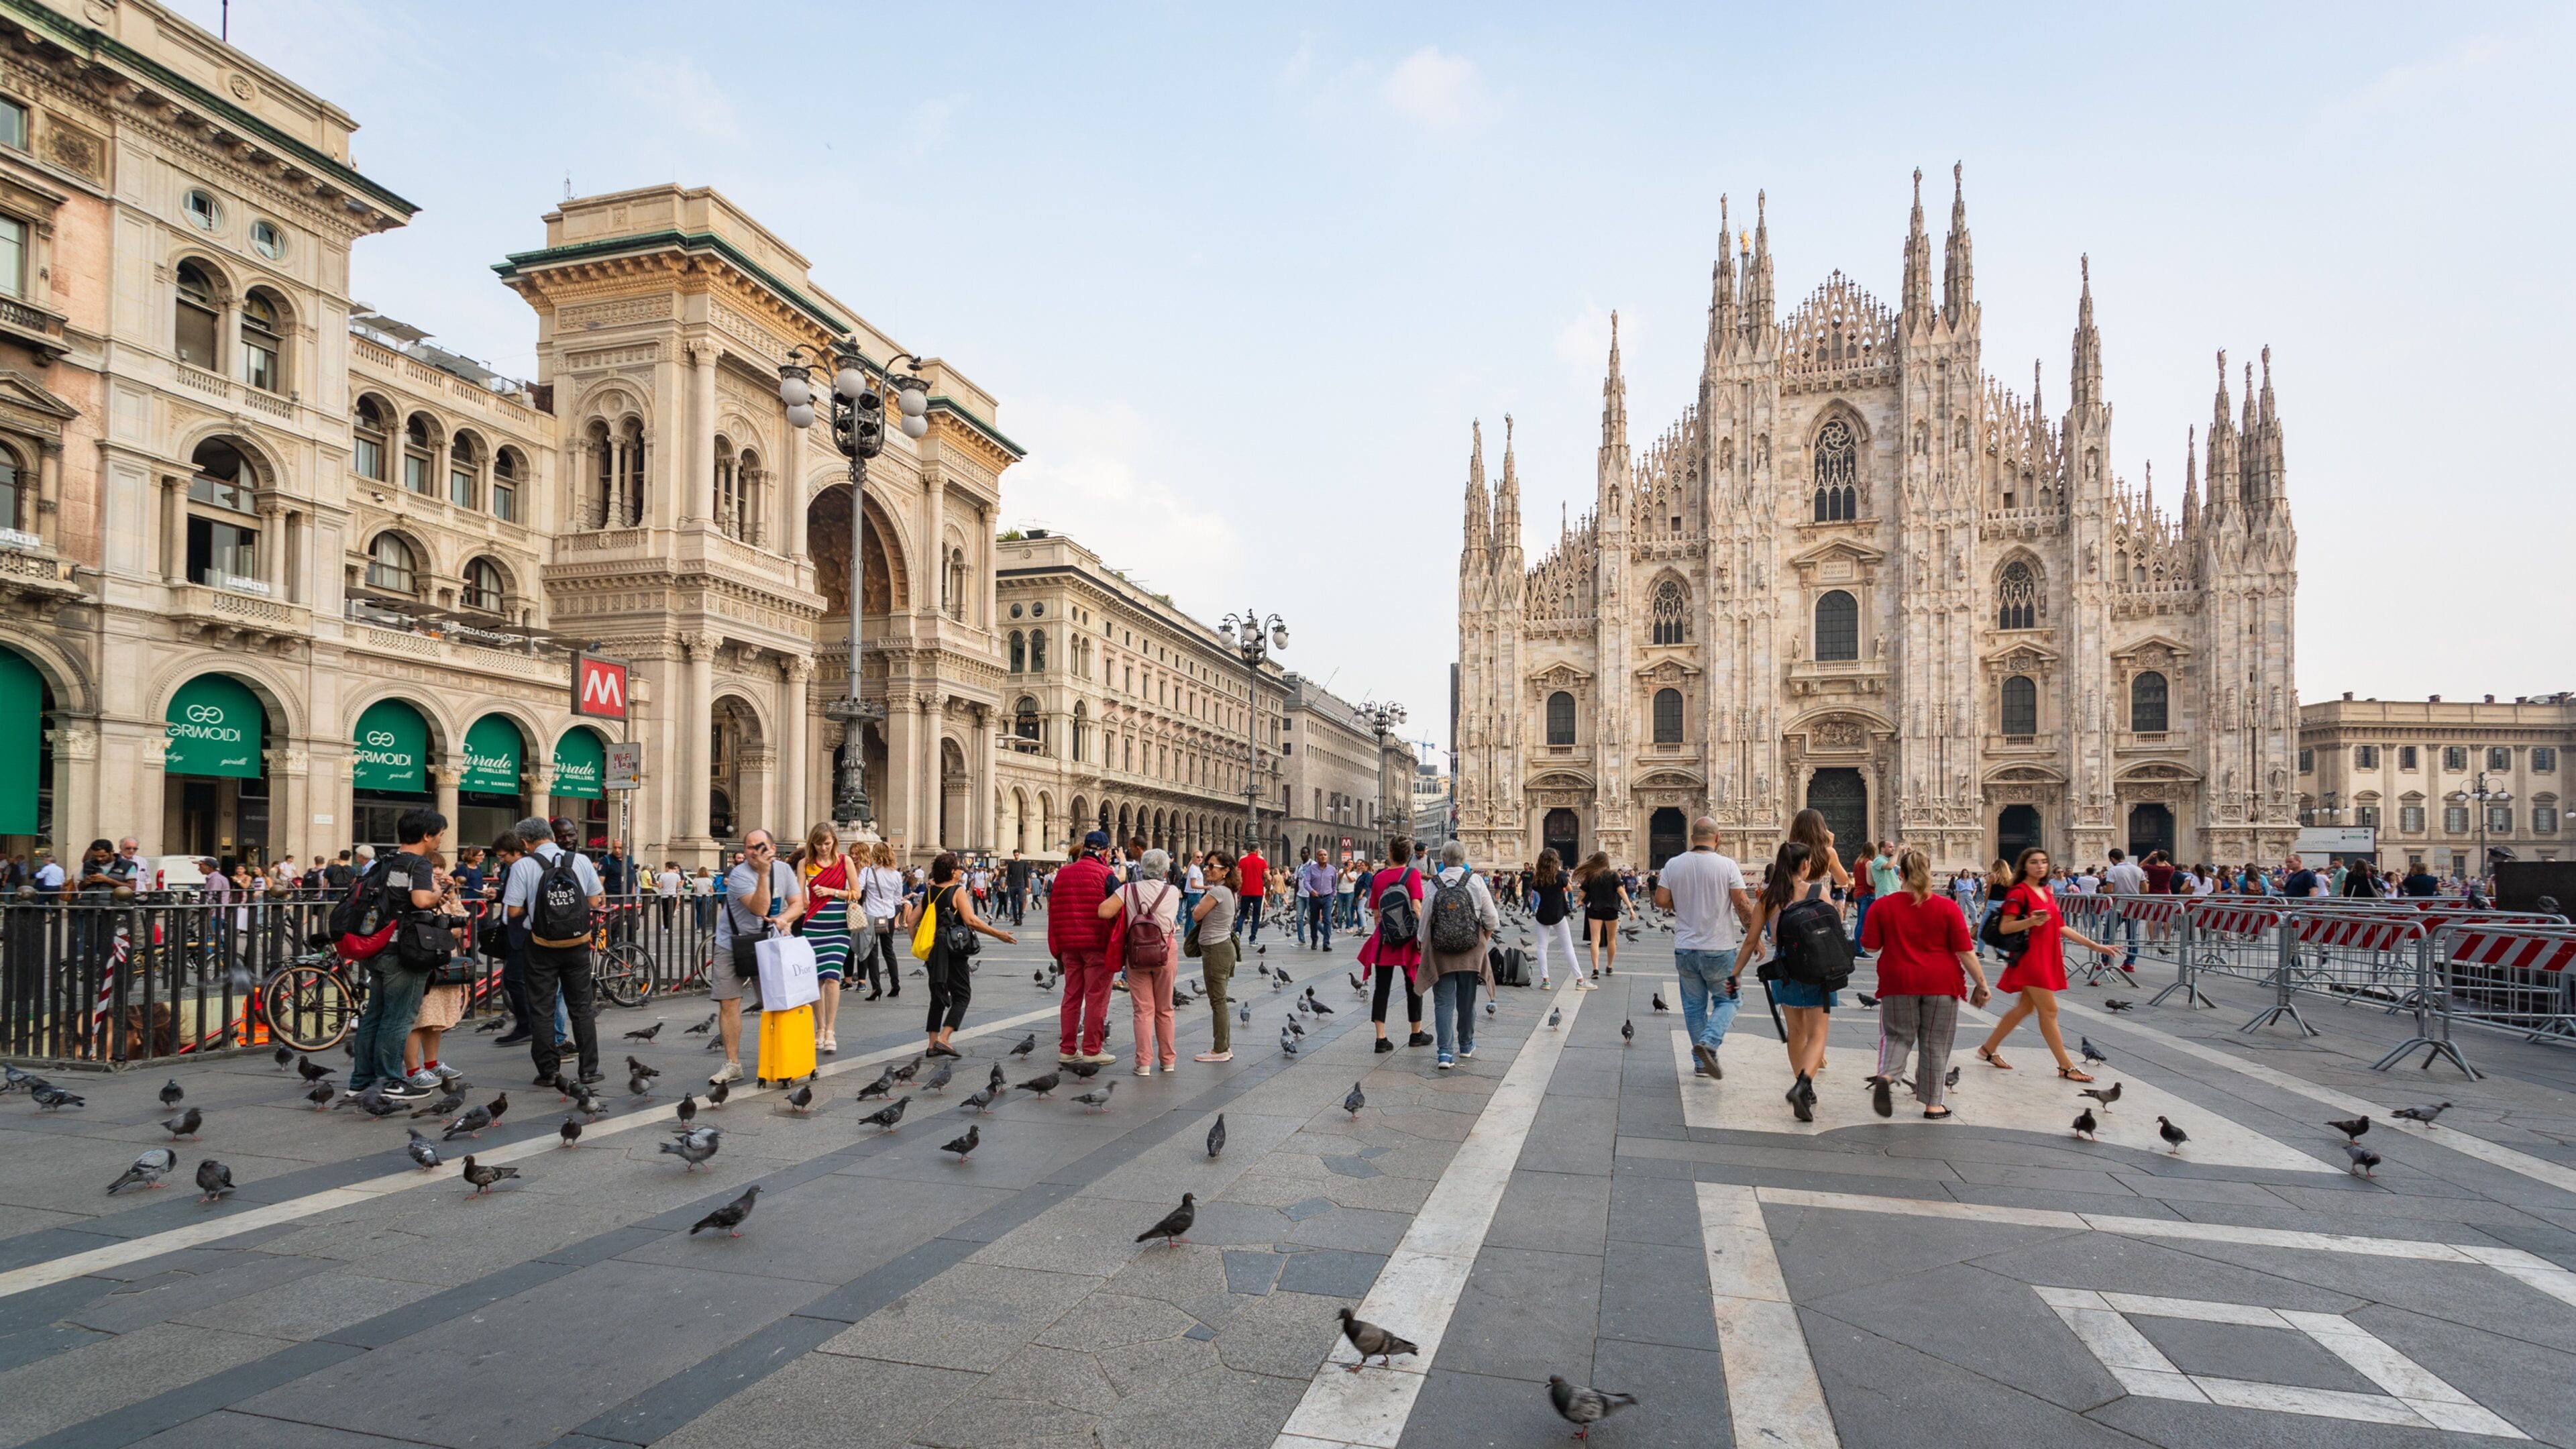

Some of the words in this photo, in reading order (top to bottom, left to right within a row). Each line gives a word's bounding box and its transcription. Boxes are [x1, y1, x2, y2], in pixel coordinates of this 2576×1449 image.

[441, 621, 480, 636] TERRAZZA
[480, 630, 508, 641] DUOMO
[582, 669, 623, 707] M
[166, 722, 240, 742] GRIMOLDI
[464, 743, 512, 769] urrado
[554, 751, 596, 775] urrado
[1342, 839, 1351, 847] M
[549, 897, 575, 906] ALLS
[792, 964, 810, 976] Dior
